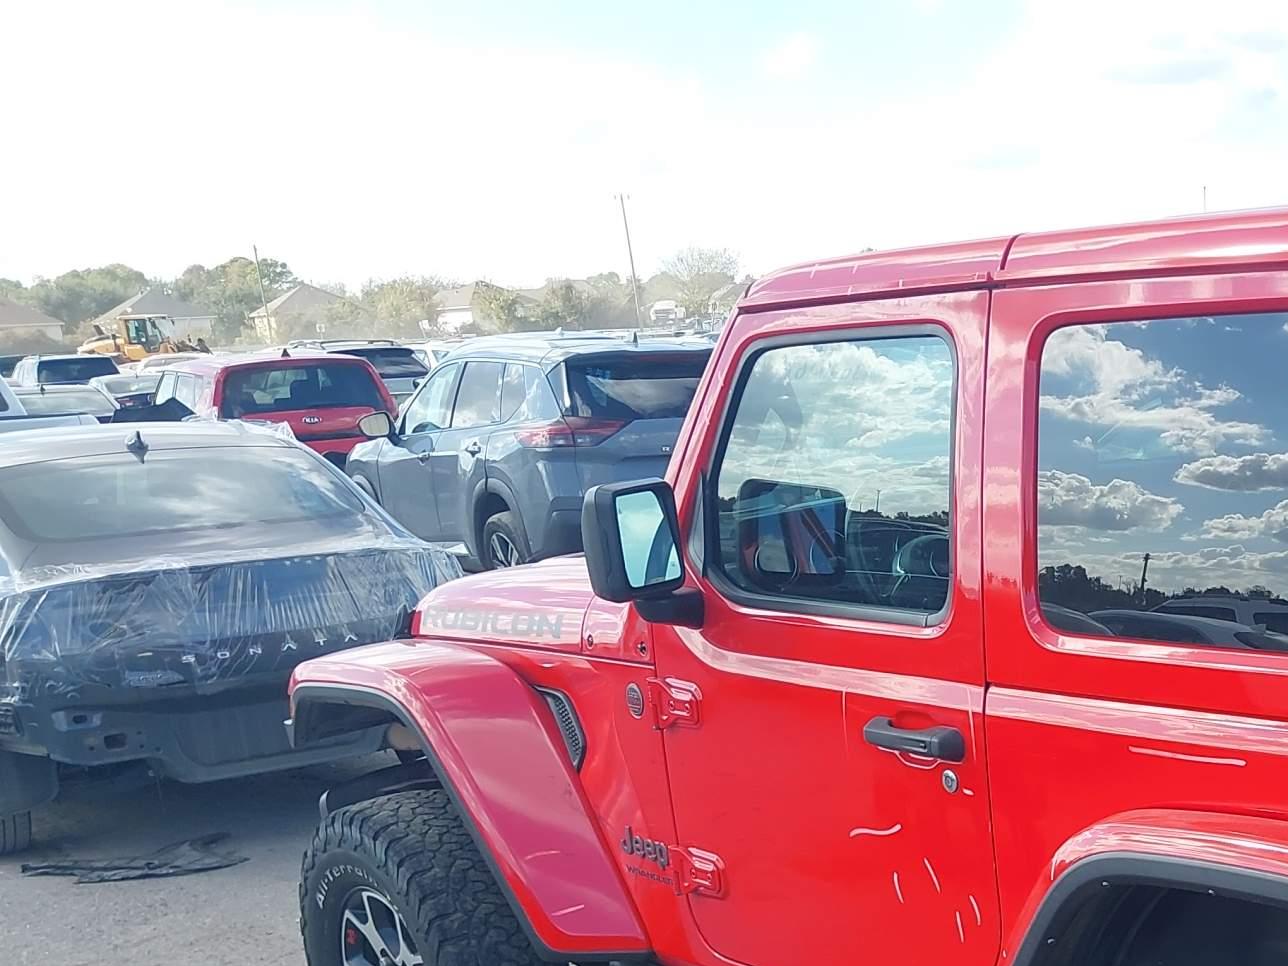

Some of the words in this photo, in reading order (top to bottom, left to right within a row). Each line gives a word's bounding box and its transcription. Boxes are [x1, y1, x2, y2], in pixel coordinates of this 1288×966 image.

[422, 605, 564, 639] RUBICON
[181, 634, 358, 664] SONATA
[621, 824, 669, 870] Jeep
